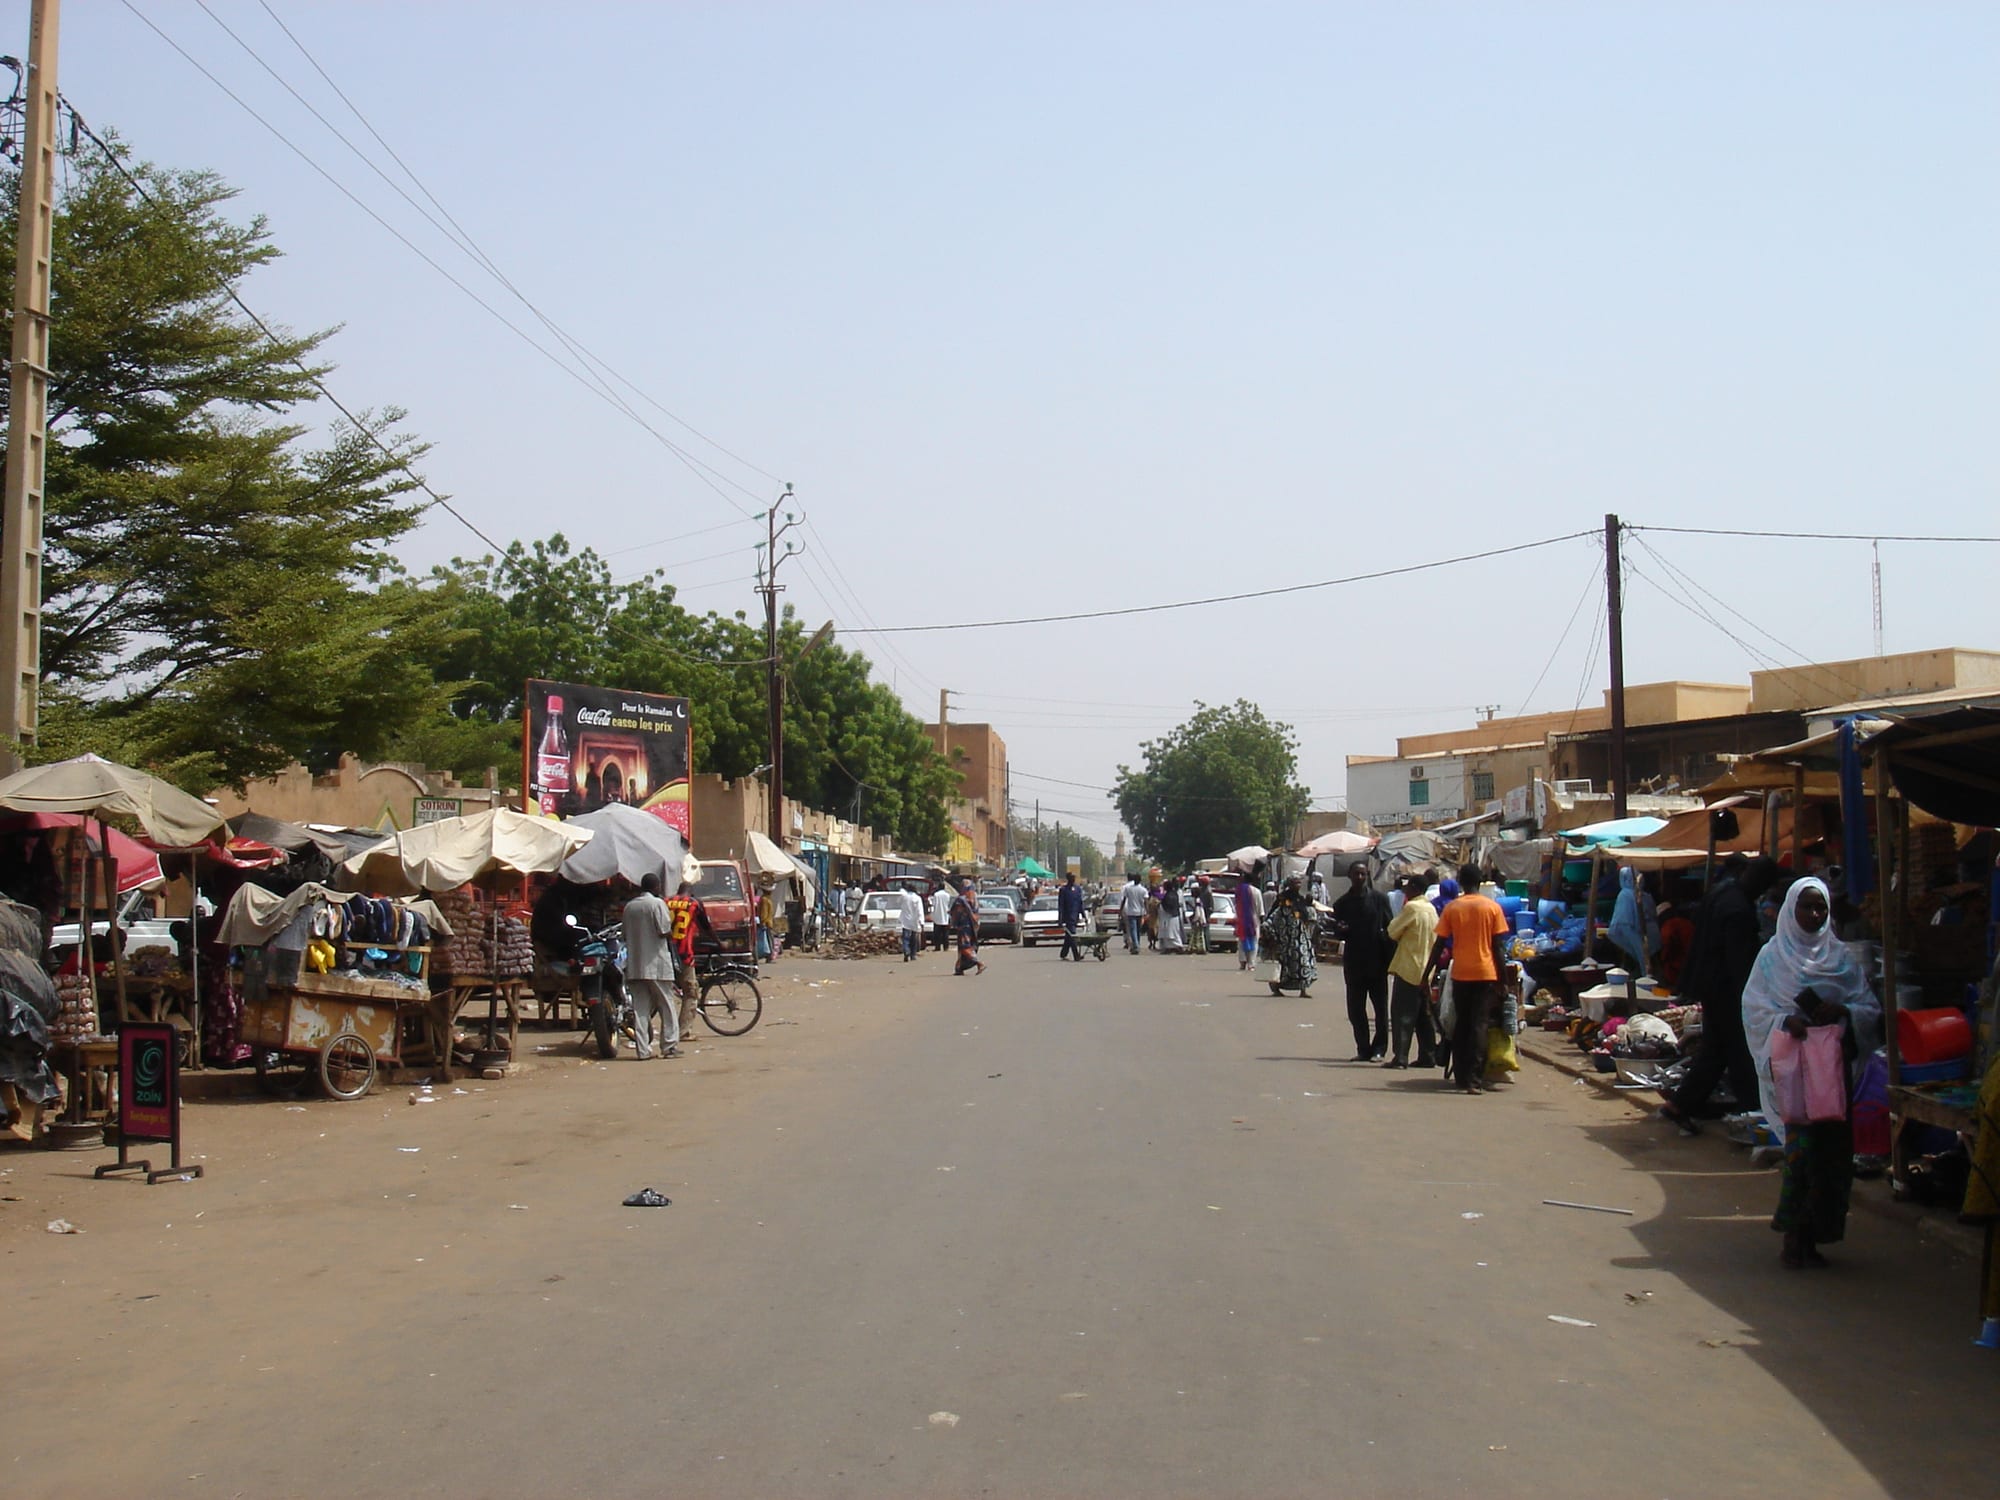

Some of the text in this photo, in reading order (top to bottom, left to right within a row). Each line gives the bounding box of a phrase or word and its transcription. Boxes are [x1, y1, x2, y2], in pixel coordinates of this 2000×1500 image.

[622, 702, 637, 712] Pour
[645, 704, 673, 717] Ramadan
[612, 716, 638, 729] casse
[639, 717, 653, 730] les
[654, 721, 673, 734] prix
[420, 800, 456, 811] SOTRUNI
